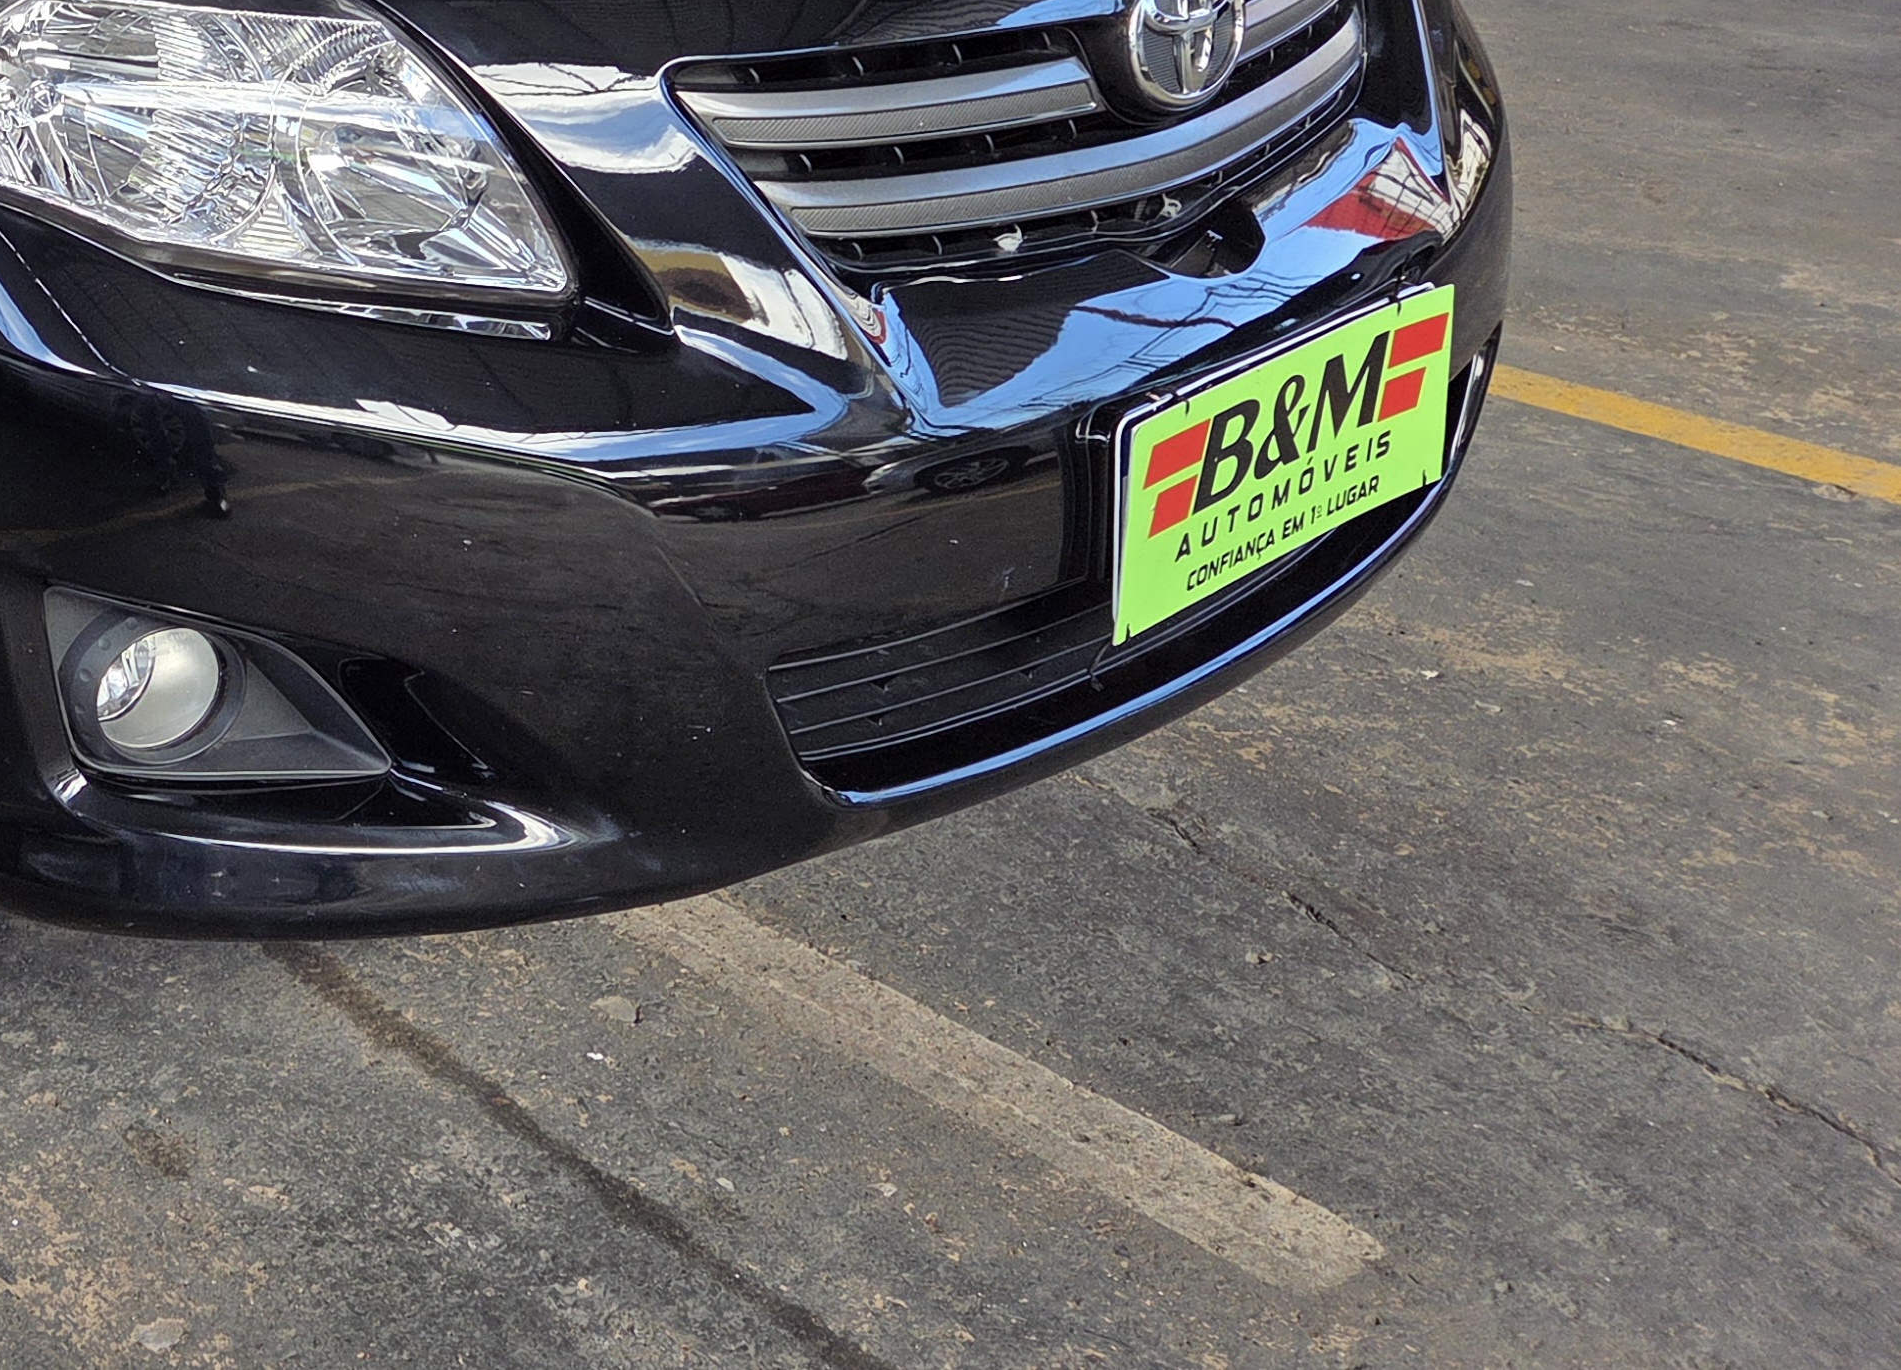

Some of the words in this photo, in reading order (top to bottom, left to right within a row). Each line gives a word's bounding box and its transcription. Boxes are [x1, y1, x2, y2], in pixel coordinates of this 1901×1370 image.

[1191, 330, 1391, 516] B&M
[1174, 430, 1392, 563] AUTOMÓVEIS
[1186, 528, 1276, 591] CONFIANÇA
[1281, 511, 1305, 540] EM
[1326, 475, 1380, 516] LUGAR
